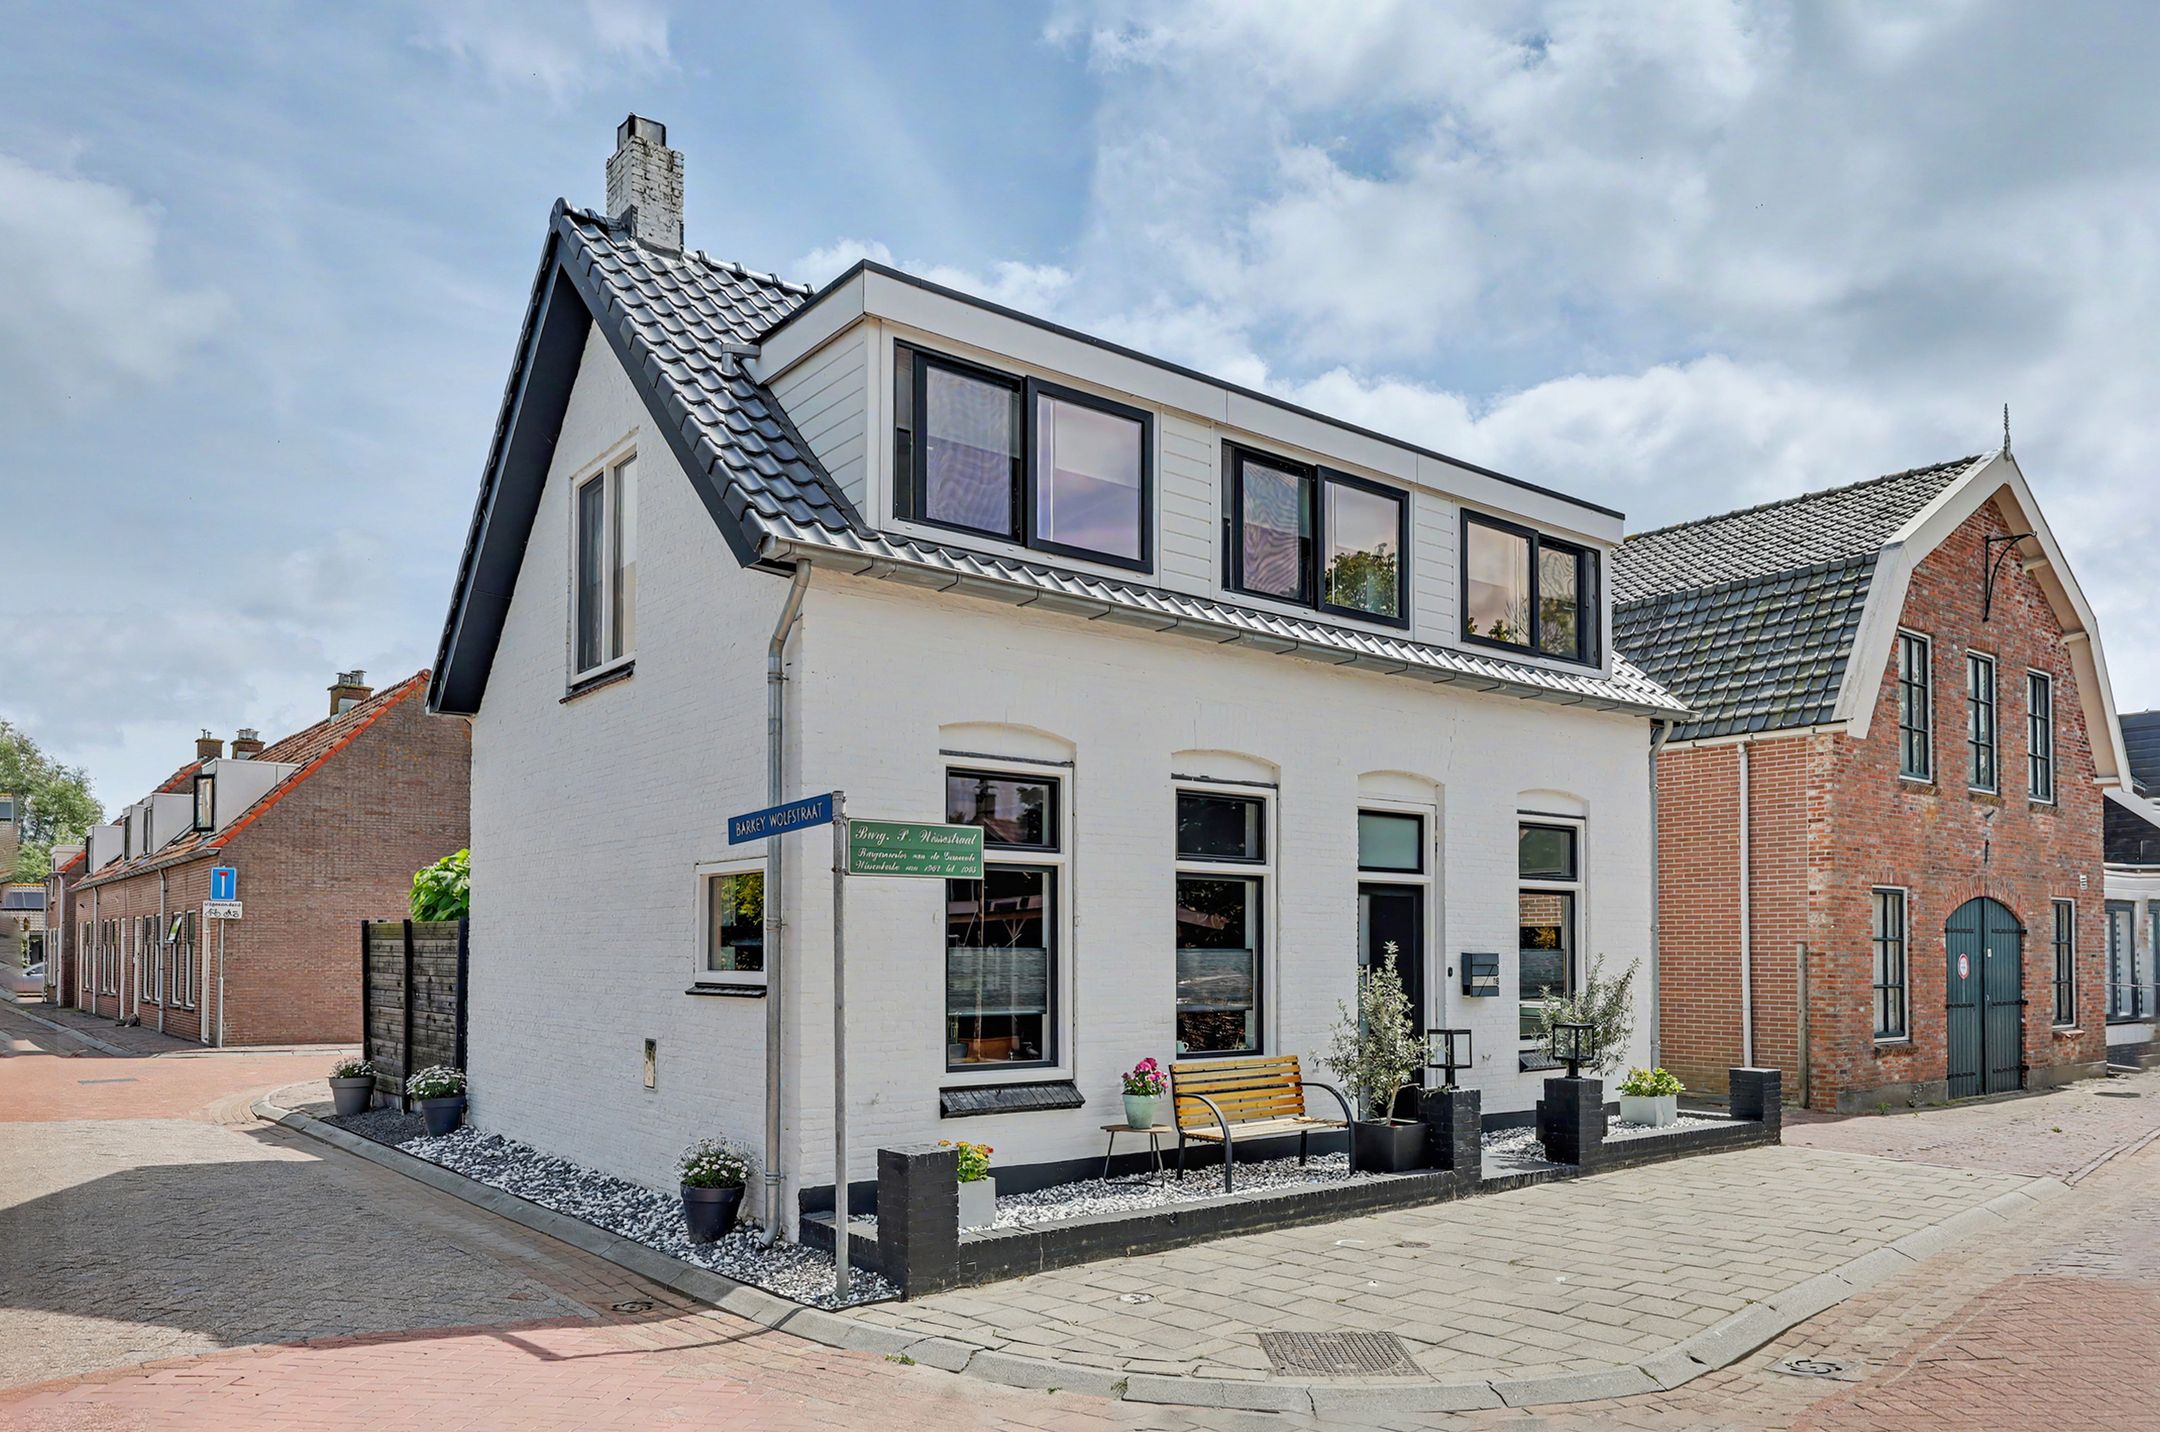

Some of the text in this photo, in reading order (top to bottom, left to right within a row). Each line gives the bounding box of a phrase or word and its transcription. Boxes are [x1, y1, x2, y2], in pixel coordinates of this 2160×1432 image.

[735, 802, 823, 837] BARKEY WOLFSTRAAT
[855, 825, 889, 846] Burg.
[919, 829, 977, 845] Wissestraat
